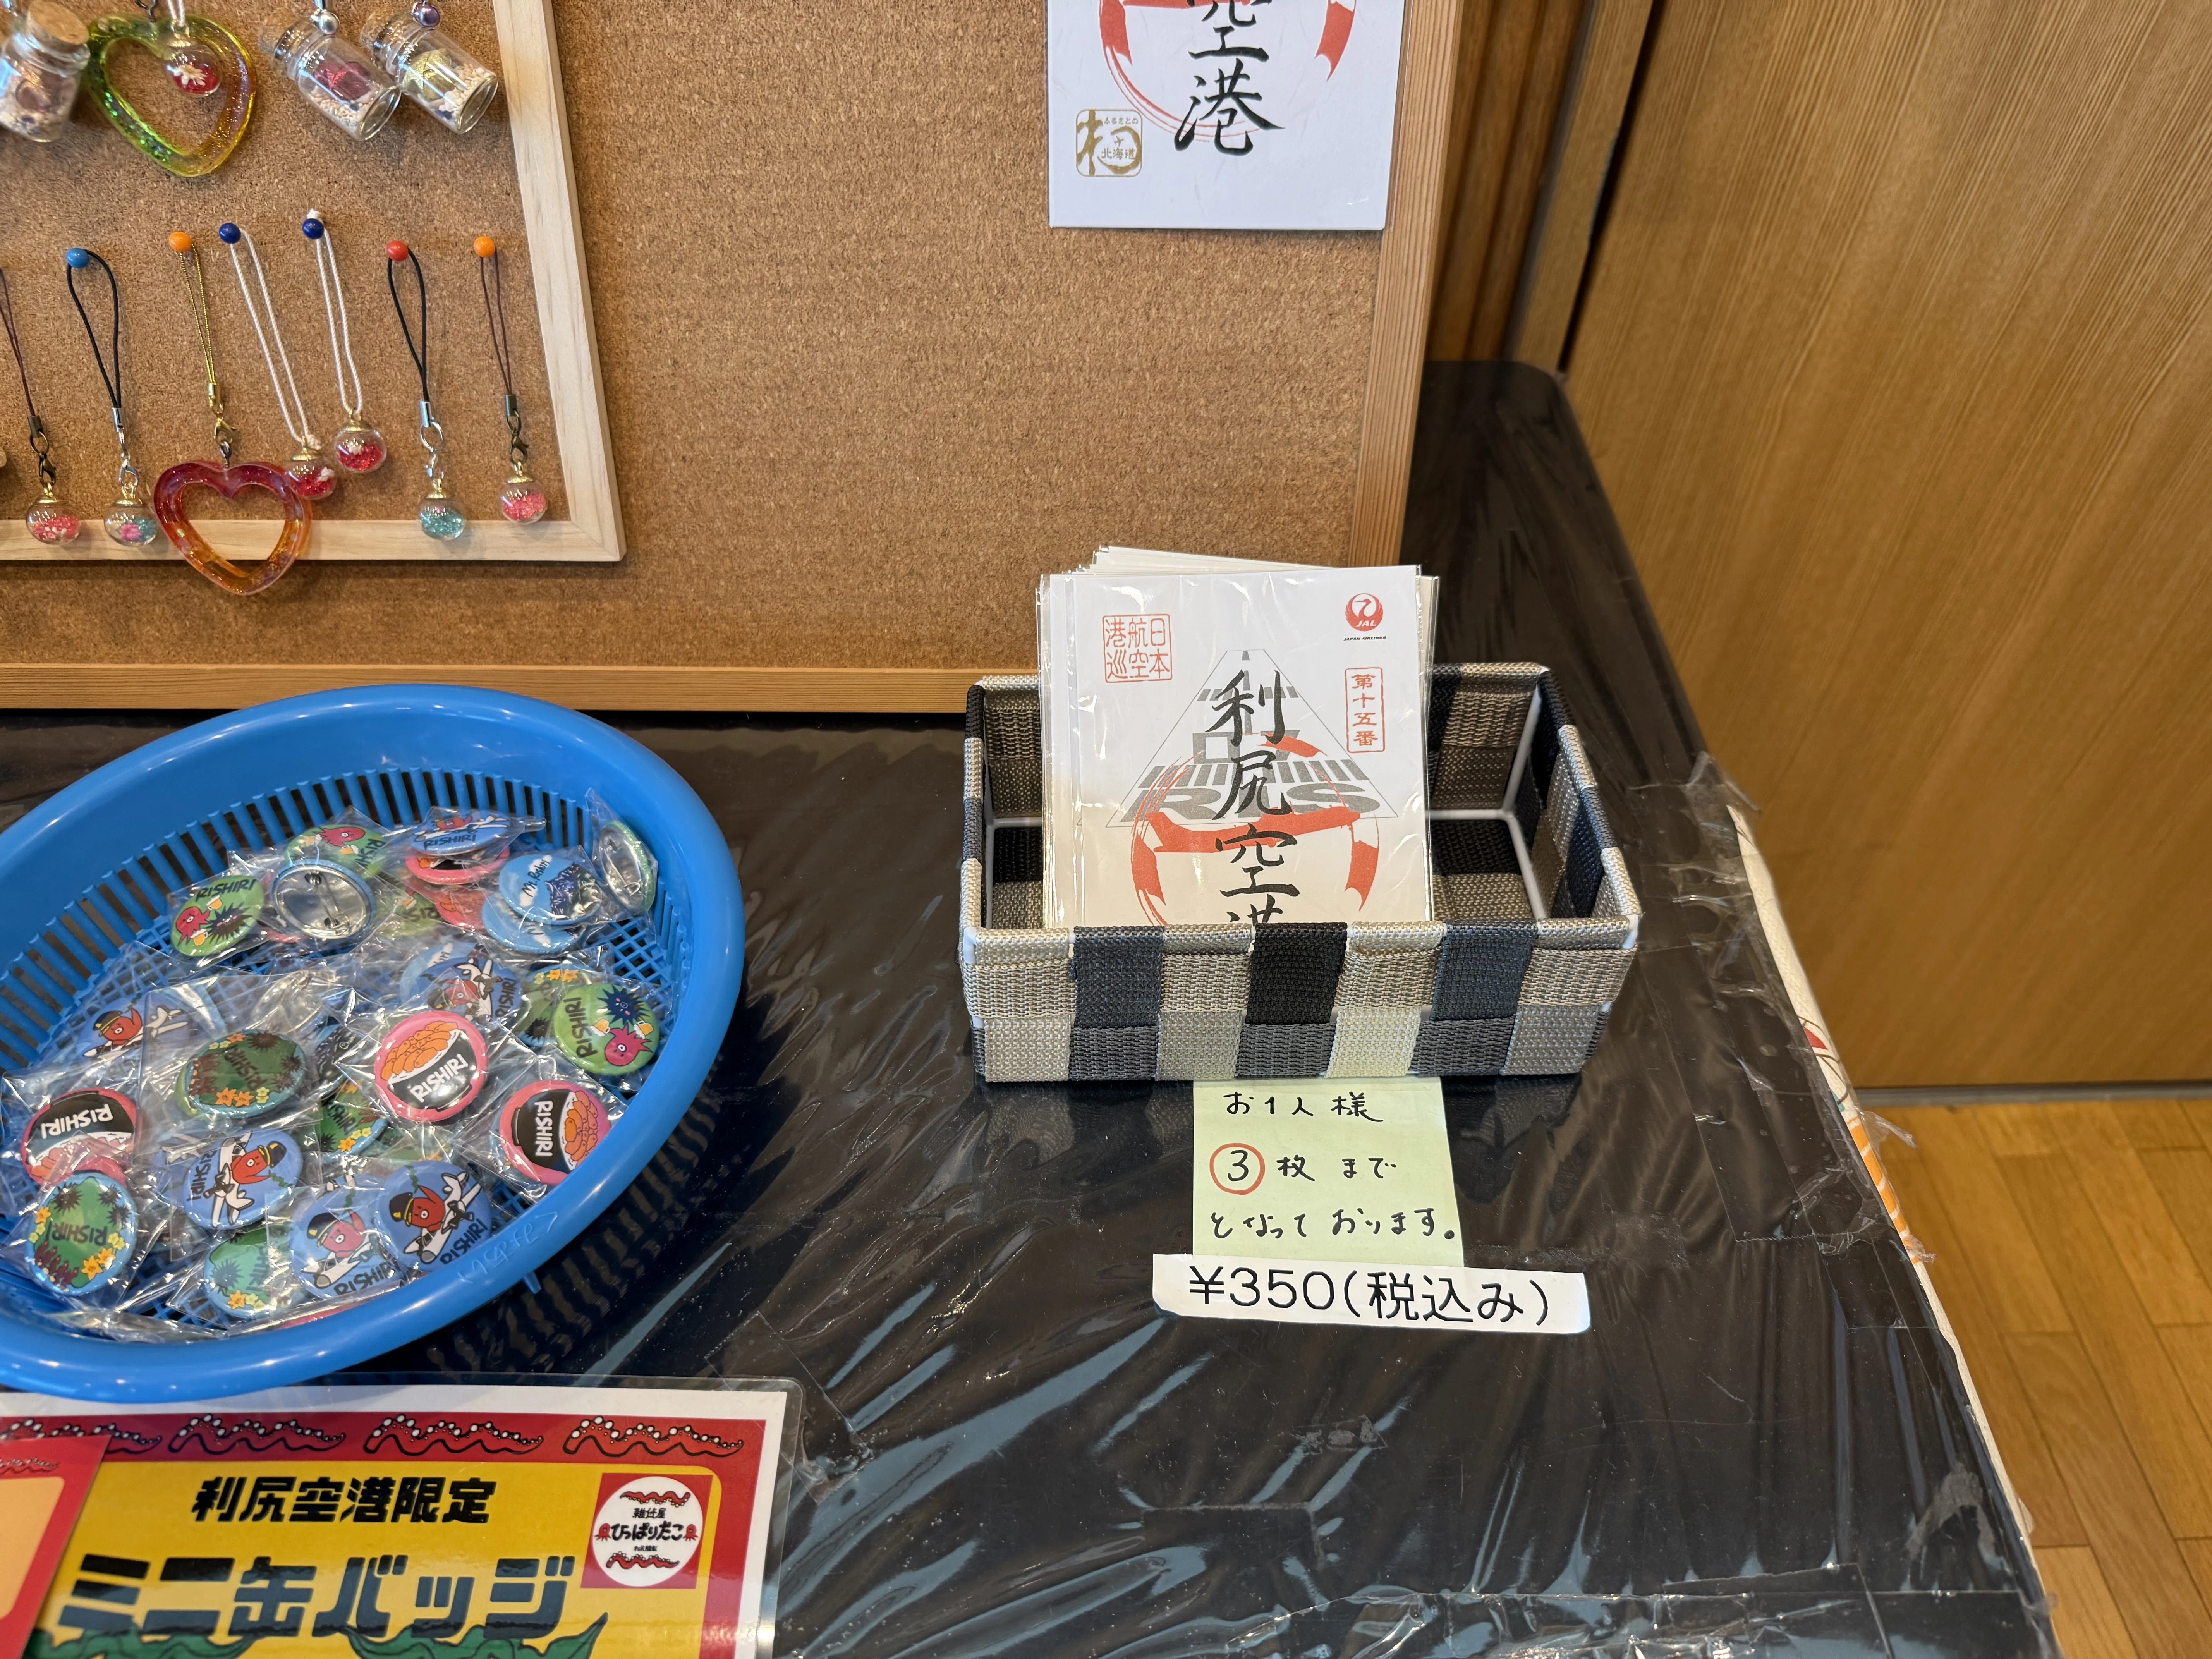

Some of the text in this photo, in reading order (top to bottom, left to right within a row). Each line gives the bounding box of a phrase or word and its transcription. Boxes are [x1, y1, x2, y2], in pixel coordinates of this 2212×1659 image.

[1101, 147, 1136, 160] 北海道
[1350, 674, 1378, 746] 第十五番
[424, 834, 477, 850] RISHIRI
[194, 878, 258, 902] RISHIRI
[495, 977, 518, 1017] RISHIRI
[563, 997, 598, 1058] RISHIRI
[410, 1053, 469, 1103] RISHIRI
[40, 1104, 114, 1139] RISHIRI
[534, 1100, 553, 1157] RISHIRI
[187, 1149, 218, 1202] RISHIRI
[45, 1221, 108, 1247] RISHIRI
[191, 1476, 496, 1525] 利尻空港限定
[611, 1520, 684, 1541] ひっぱりだこ
[58, 1554, 576, 1638] ミニ缶バッジ
